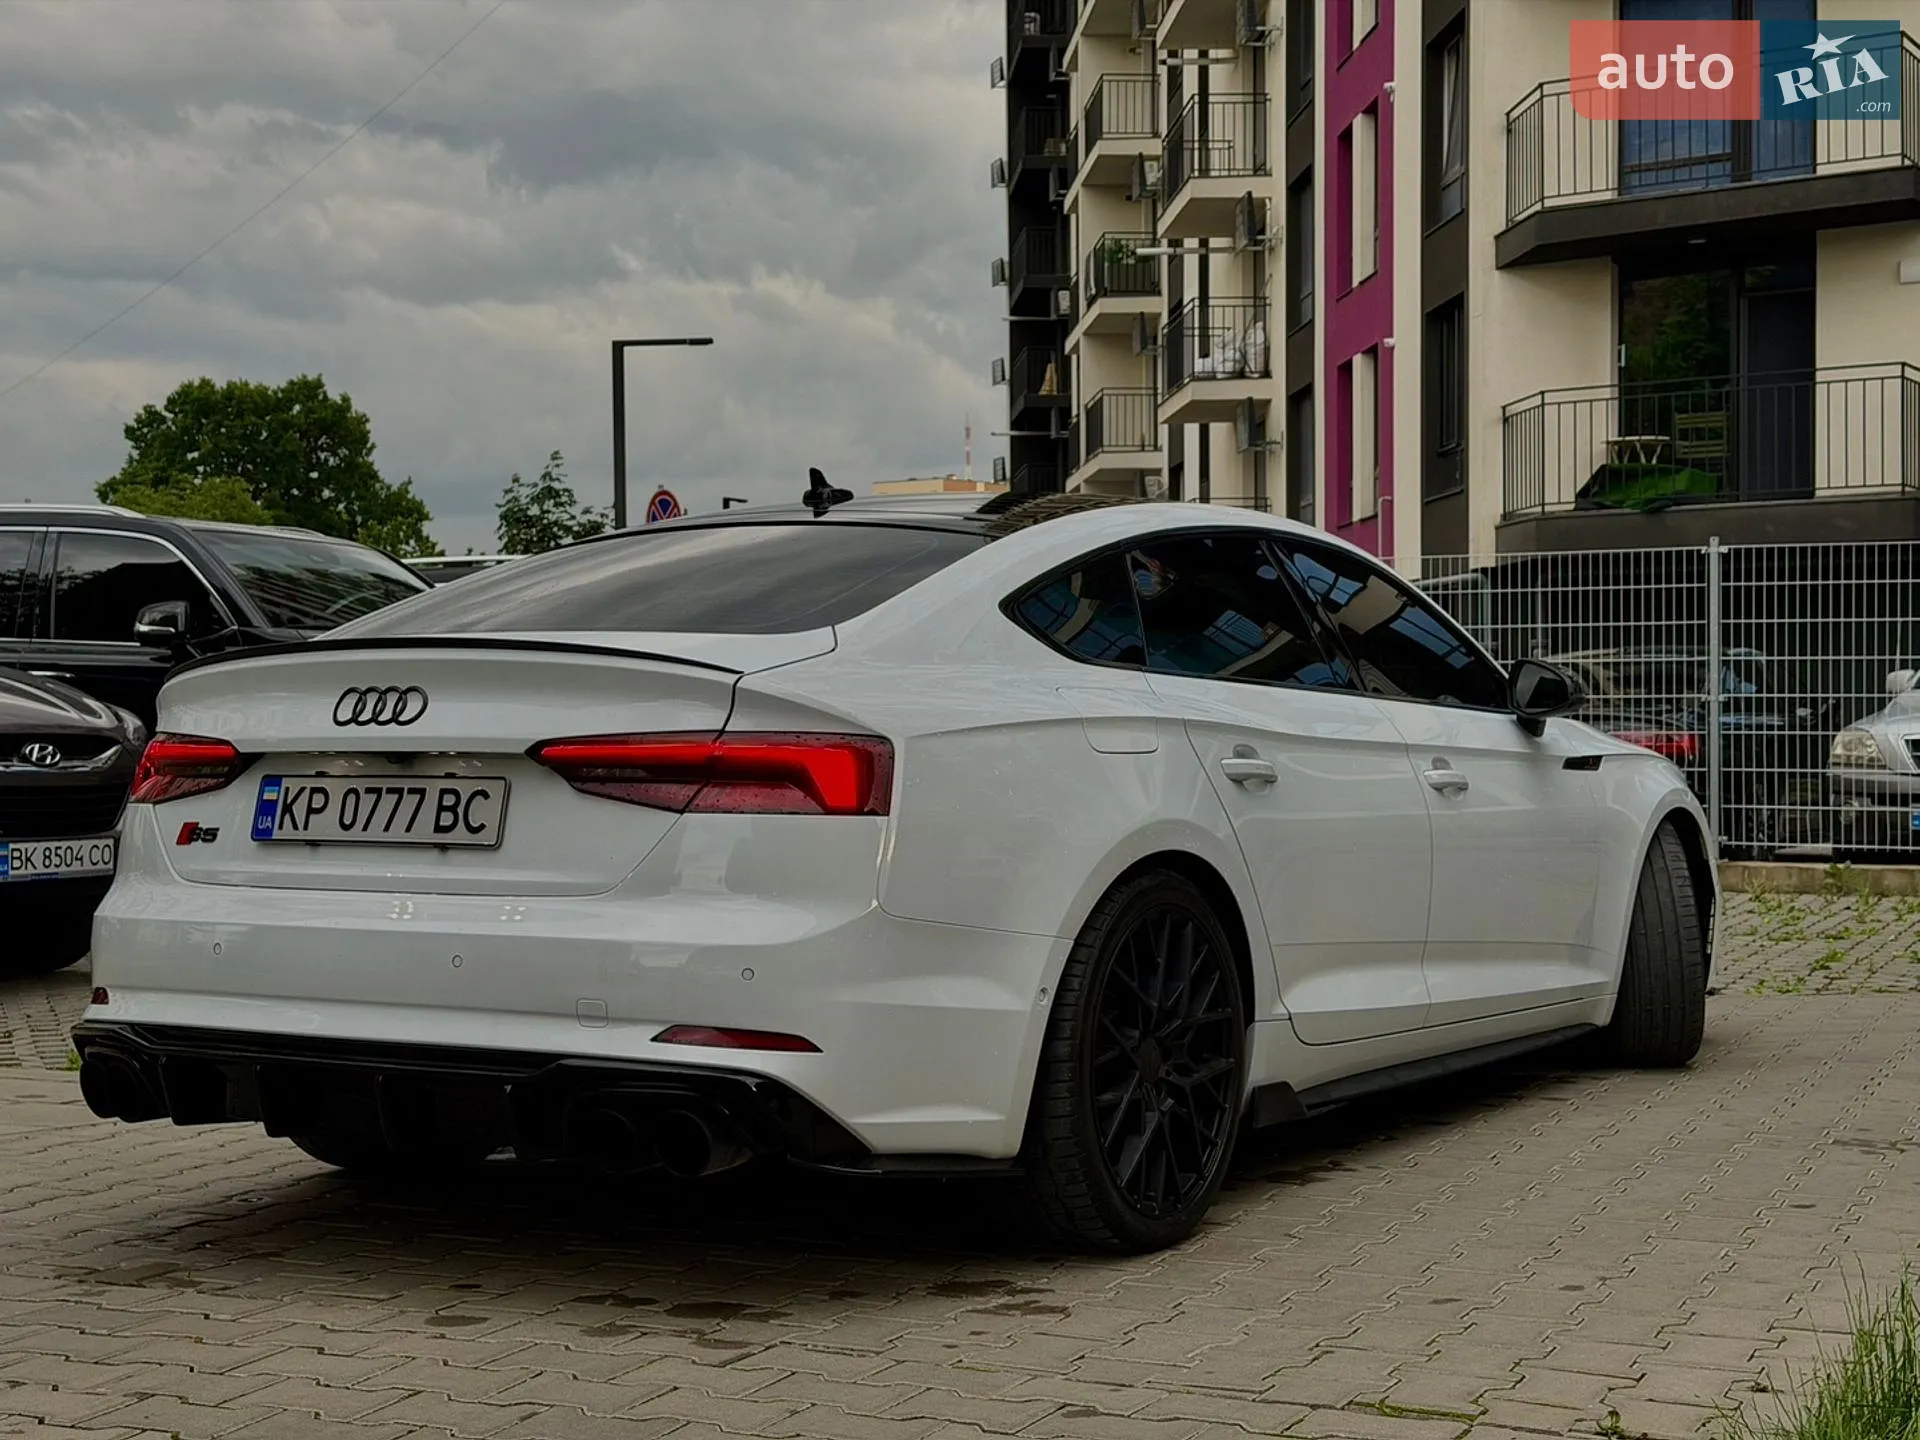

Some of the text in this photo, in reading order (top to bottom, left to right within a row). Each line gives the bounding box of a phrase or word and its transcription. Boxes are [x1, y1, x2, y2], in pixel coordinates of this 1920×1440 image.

[257, 815, 272, 830] UA
[278, 786, 491, 835] KP 0777 BC
[10, 843, 112, 871] BK 8504 CO
